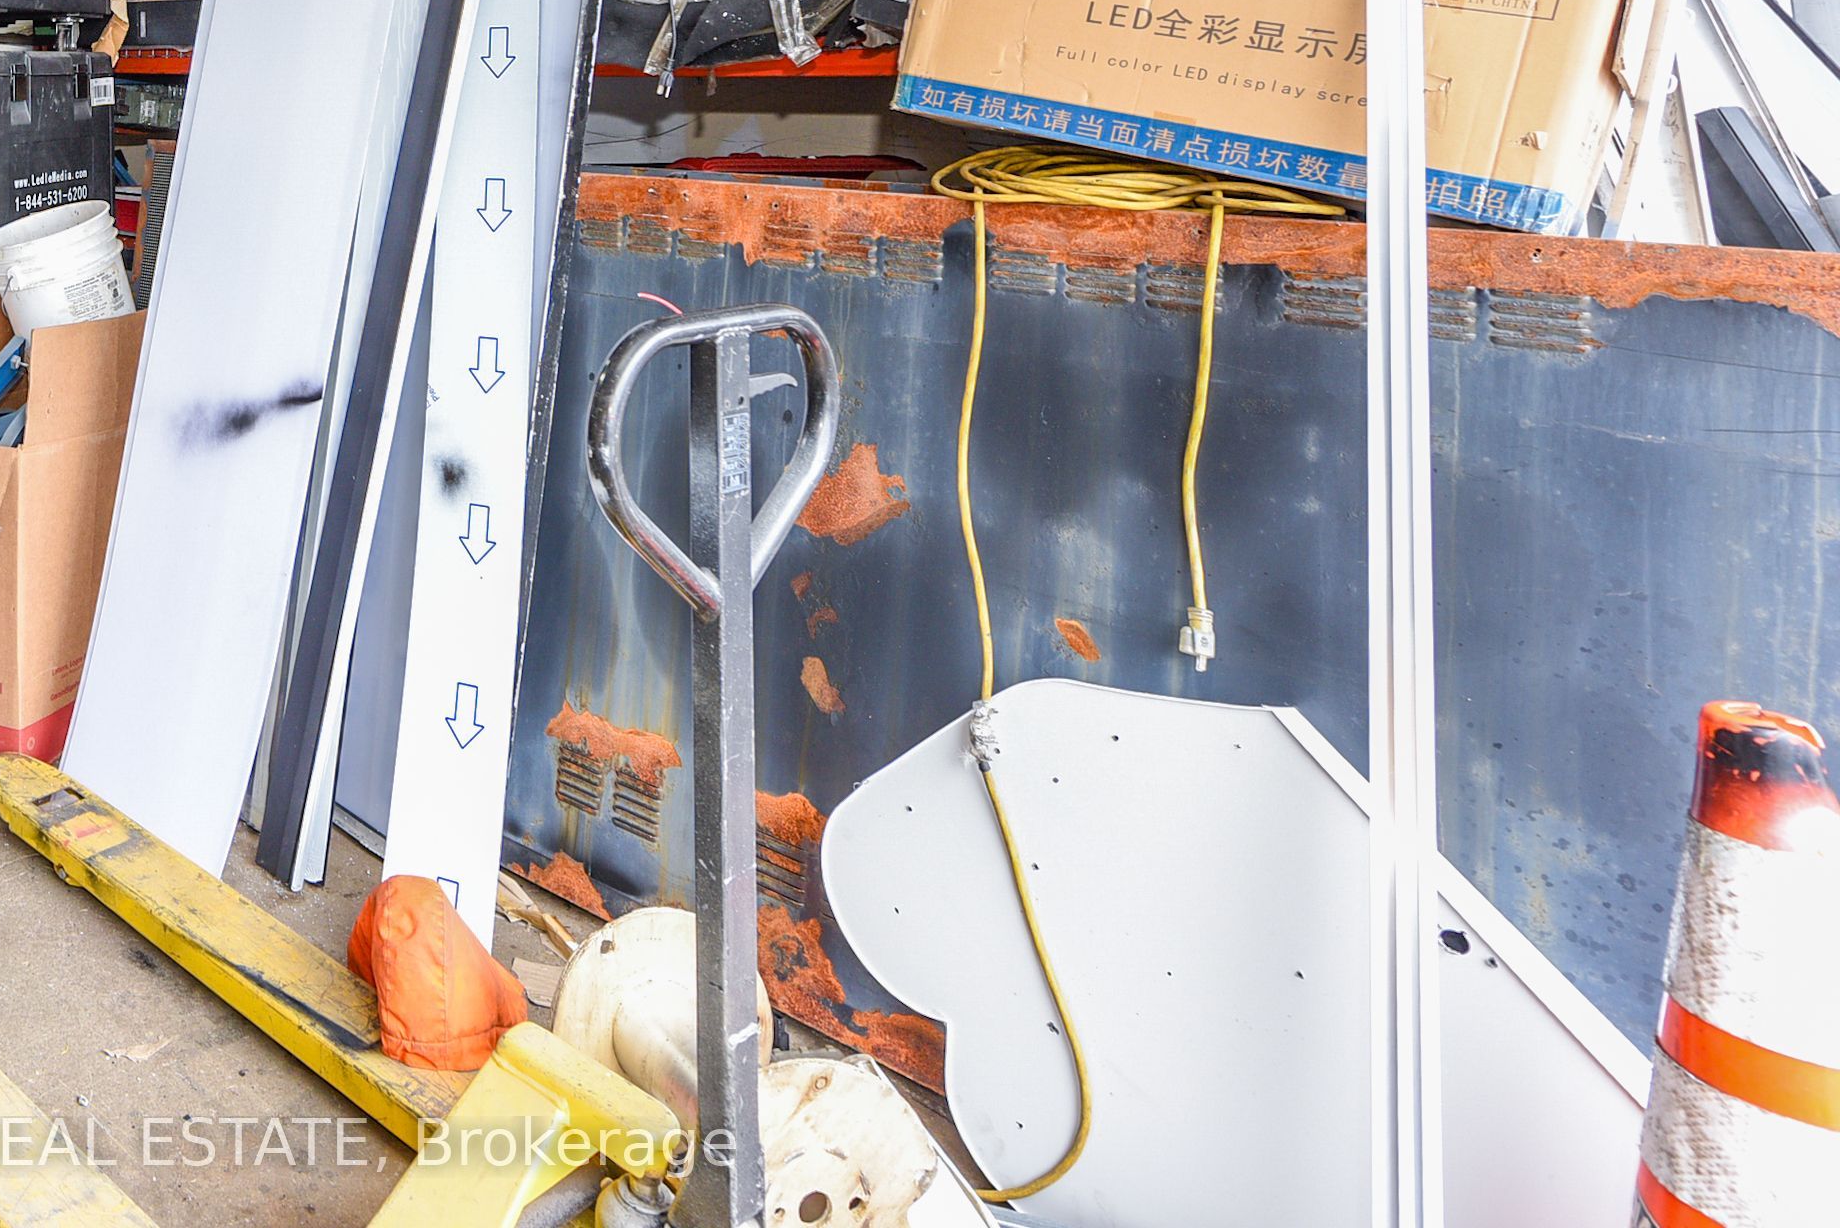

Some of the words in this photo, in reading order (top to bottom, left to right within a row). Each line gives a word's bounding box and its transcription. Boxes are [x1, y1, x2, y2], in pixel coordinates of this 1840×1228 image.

[1055, 45, 1098, 64] Full
[1106, 54, 1163, 74] color
[1172, 63, 1209, 81] LED
[1217, 72, 1306, 99] display
[1316, 88, 1367, 107] scre
[920, 84, 1509, 218] 如有损坏请当面清点损坏数量拍照
[15, 184, 88, 212] 1-844-531-6200
